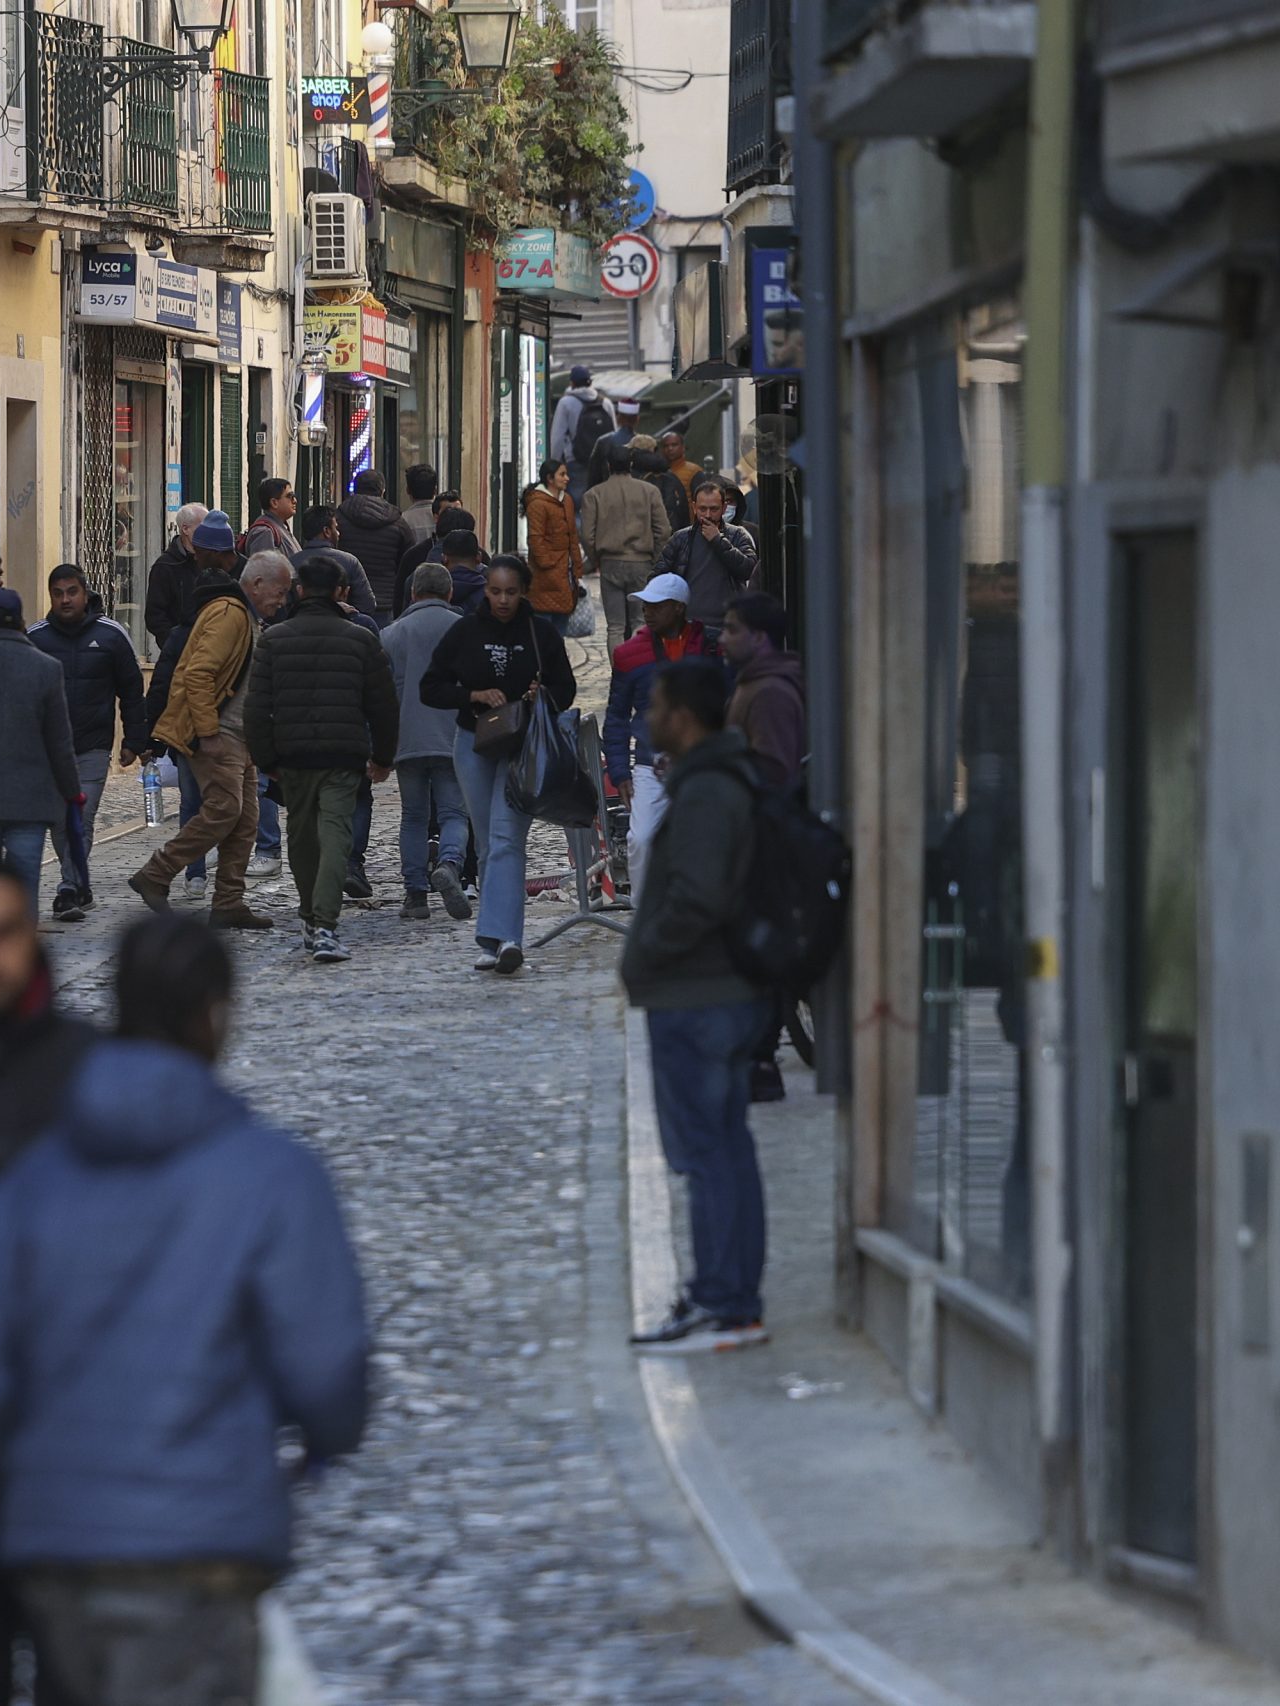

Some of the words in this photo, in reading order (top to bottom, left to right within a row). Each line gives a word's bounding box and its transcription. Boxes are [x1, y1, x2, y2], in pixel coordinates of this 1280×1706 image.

[301, 79, 350, 94] BARBER
[312, 93, 340, 110] shop
[507, 242, 524, 252] SKY
[527, 242, 552, 252] ZONE
[88, 259, 120, 274] Lyca
[498, 258, 554, 278] 67-A
[607, 253, 647, 278] 30
[90, 294, 127, 306] 53/57
[535, 397, 544, 446] STORE
